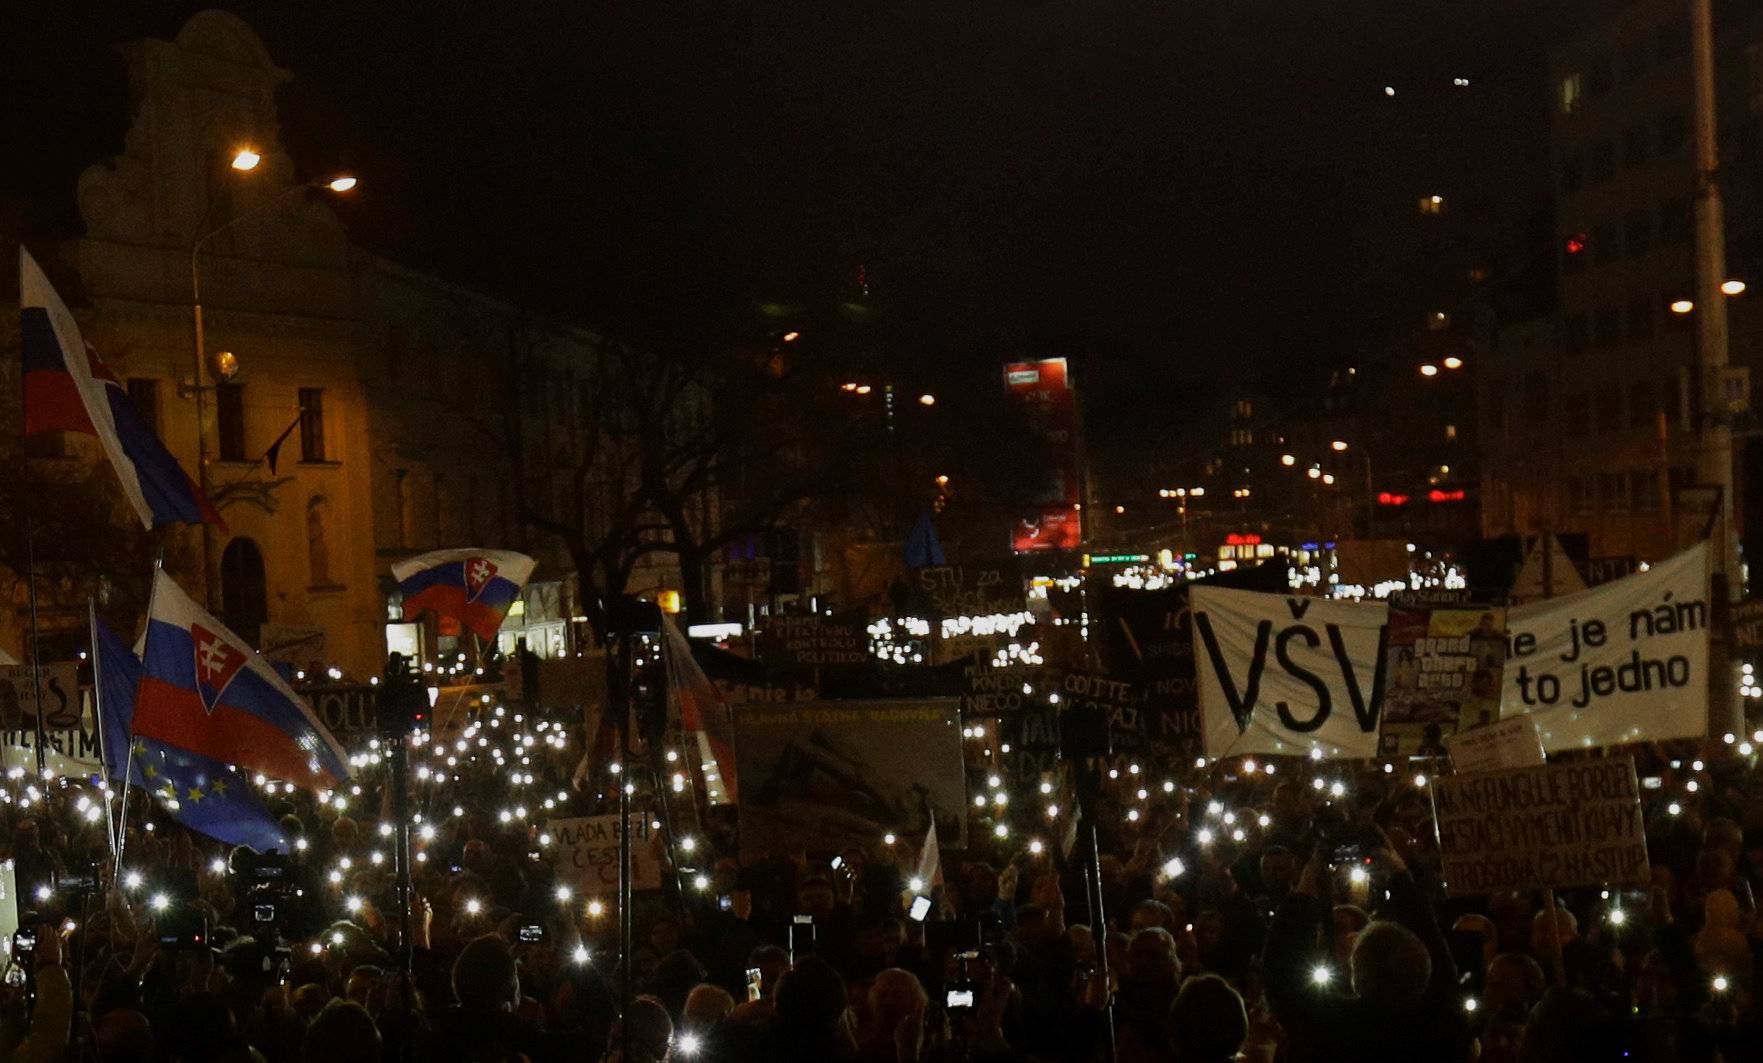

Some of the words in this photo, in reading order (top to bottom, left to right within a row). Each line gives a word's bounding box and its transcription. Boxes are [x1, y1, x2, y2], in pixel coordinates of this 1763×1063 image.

[1561, 619, 1607, 662] je
[1630, 591, 1706, 639] nám
[1194, 599, 1388, 735] VŠV
[1516, 666, 1560, 705] to
[1573, 648, 1690, 708] jedno
